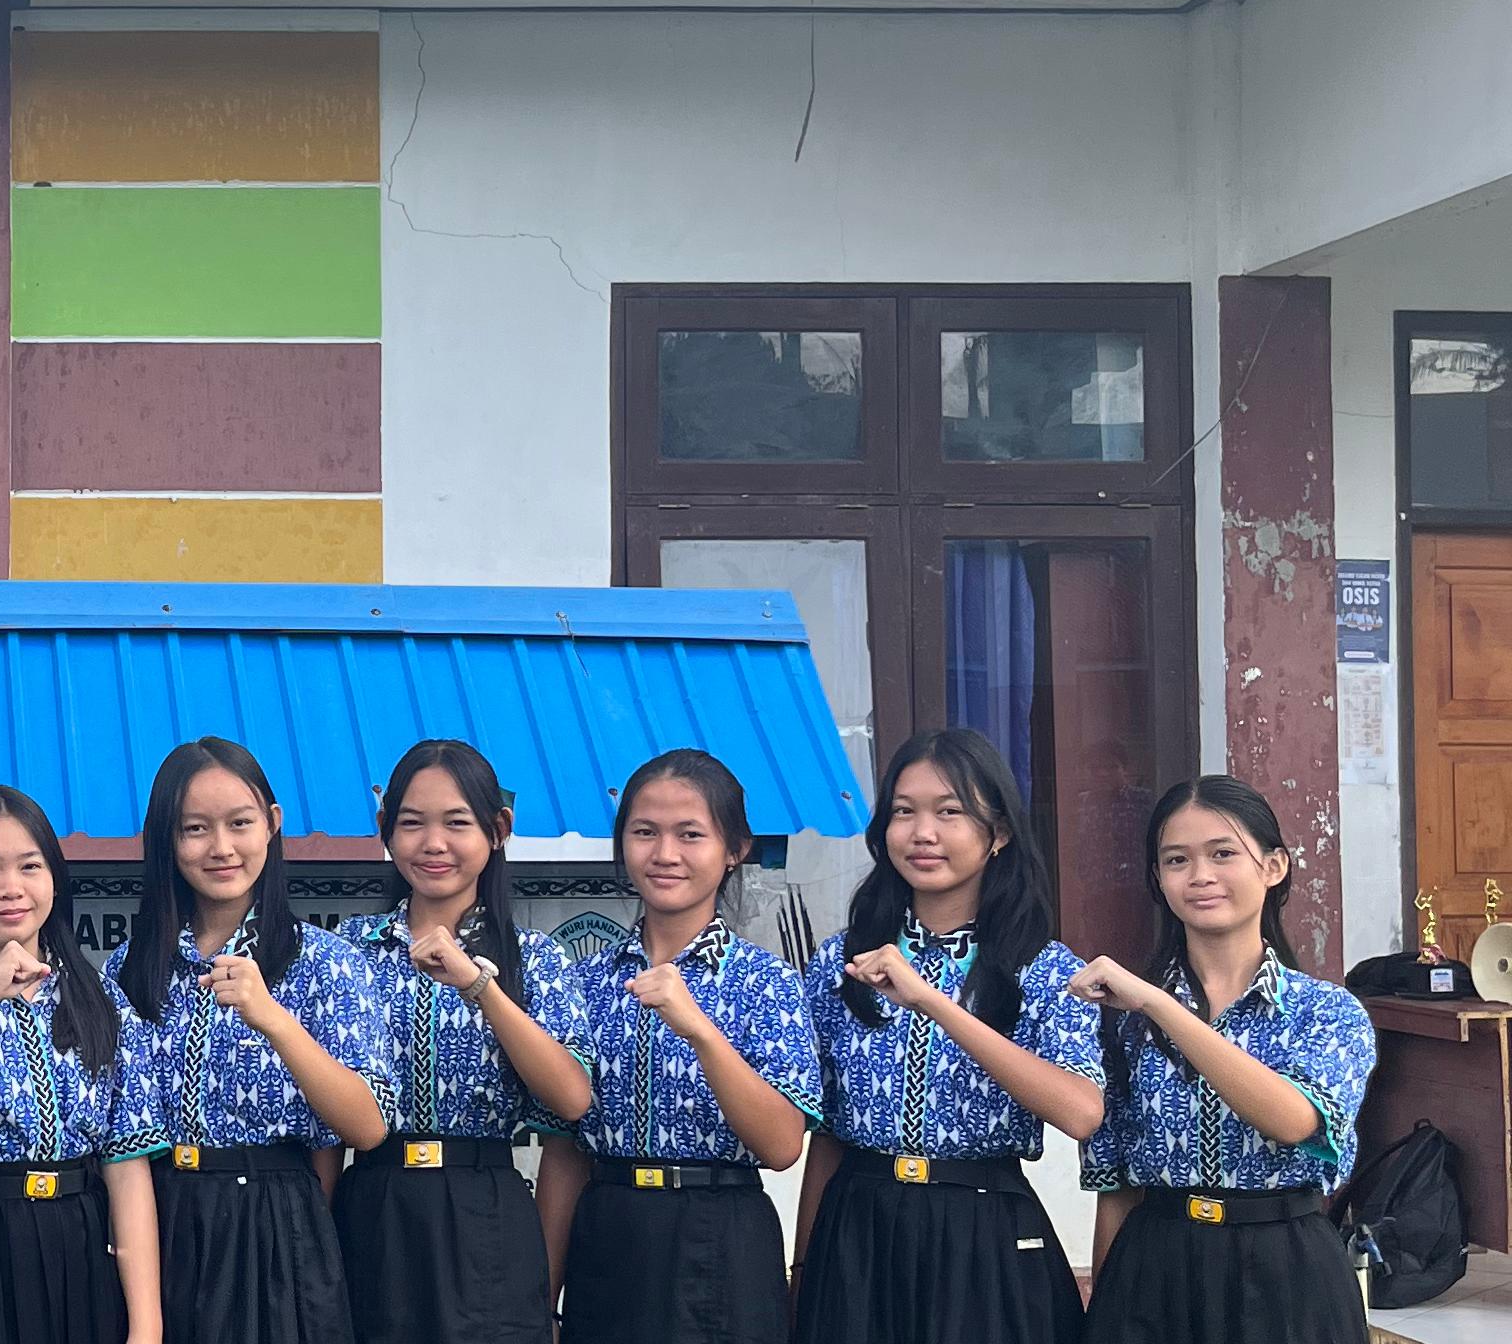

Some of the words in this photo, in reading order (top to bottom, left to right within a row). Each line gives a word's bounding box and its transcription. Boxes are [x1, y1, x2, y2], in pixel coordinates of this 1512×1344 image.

[1343, 587, 1380, 605] OSIS
[558, 920, 585, 939] WURI
[587, 920, 626, 942] HANDAY
